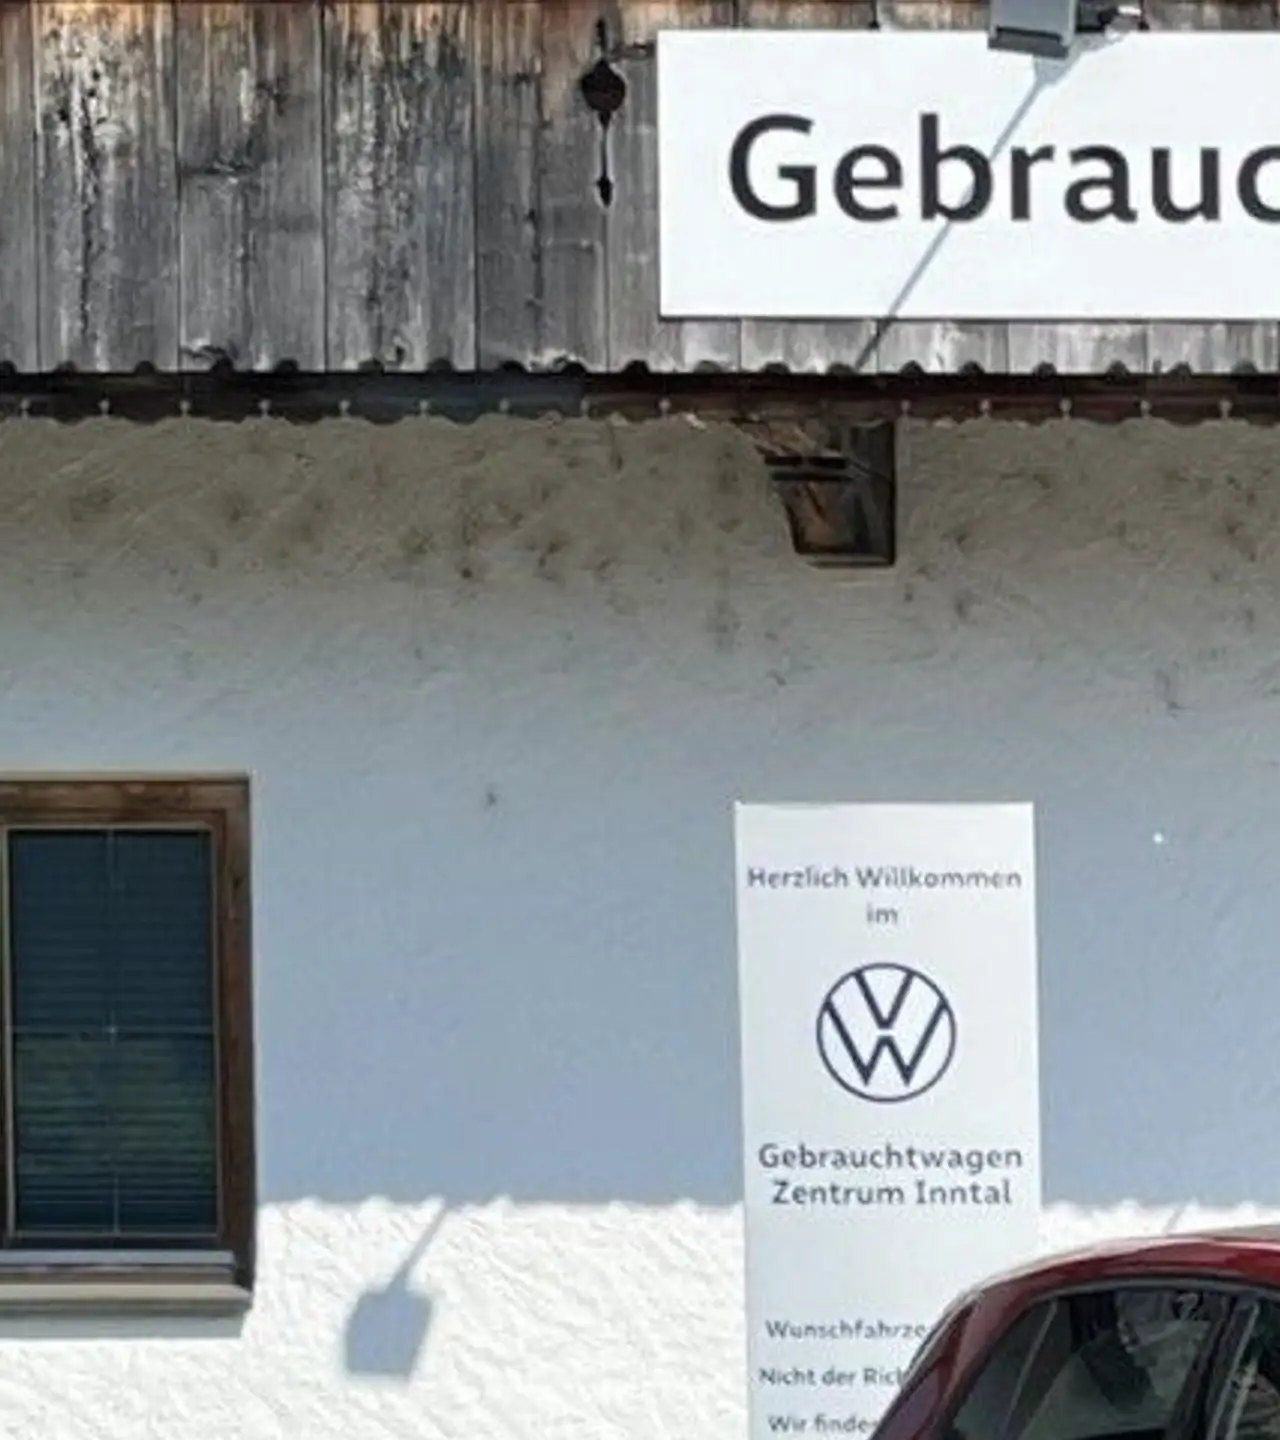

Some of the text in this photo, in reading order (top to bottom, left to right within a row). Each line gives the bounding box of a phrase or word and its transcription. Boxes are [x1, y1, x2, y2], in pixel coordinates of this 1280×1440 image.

[747, 864, 1022, 889] Herzlich Willkommen
[866, 905, 899, 924] im
[758, 1142, 1023, 1173] Gebrauchtwagen
[771, 1178, 1012, 1206] Zentrum Inntal
[765, 1319, 932, 1341] Wunschfahrze
[759, 1367, 815, 1387] Nicht
[821, 1367, 856, 1387] der
[768, 1412, 878, 1434] Wir finde
